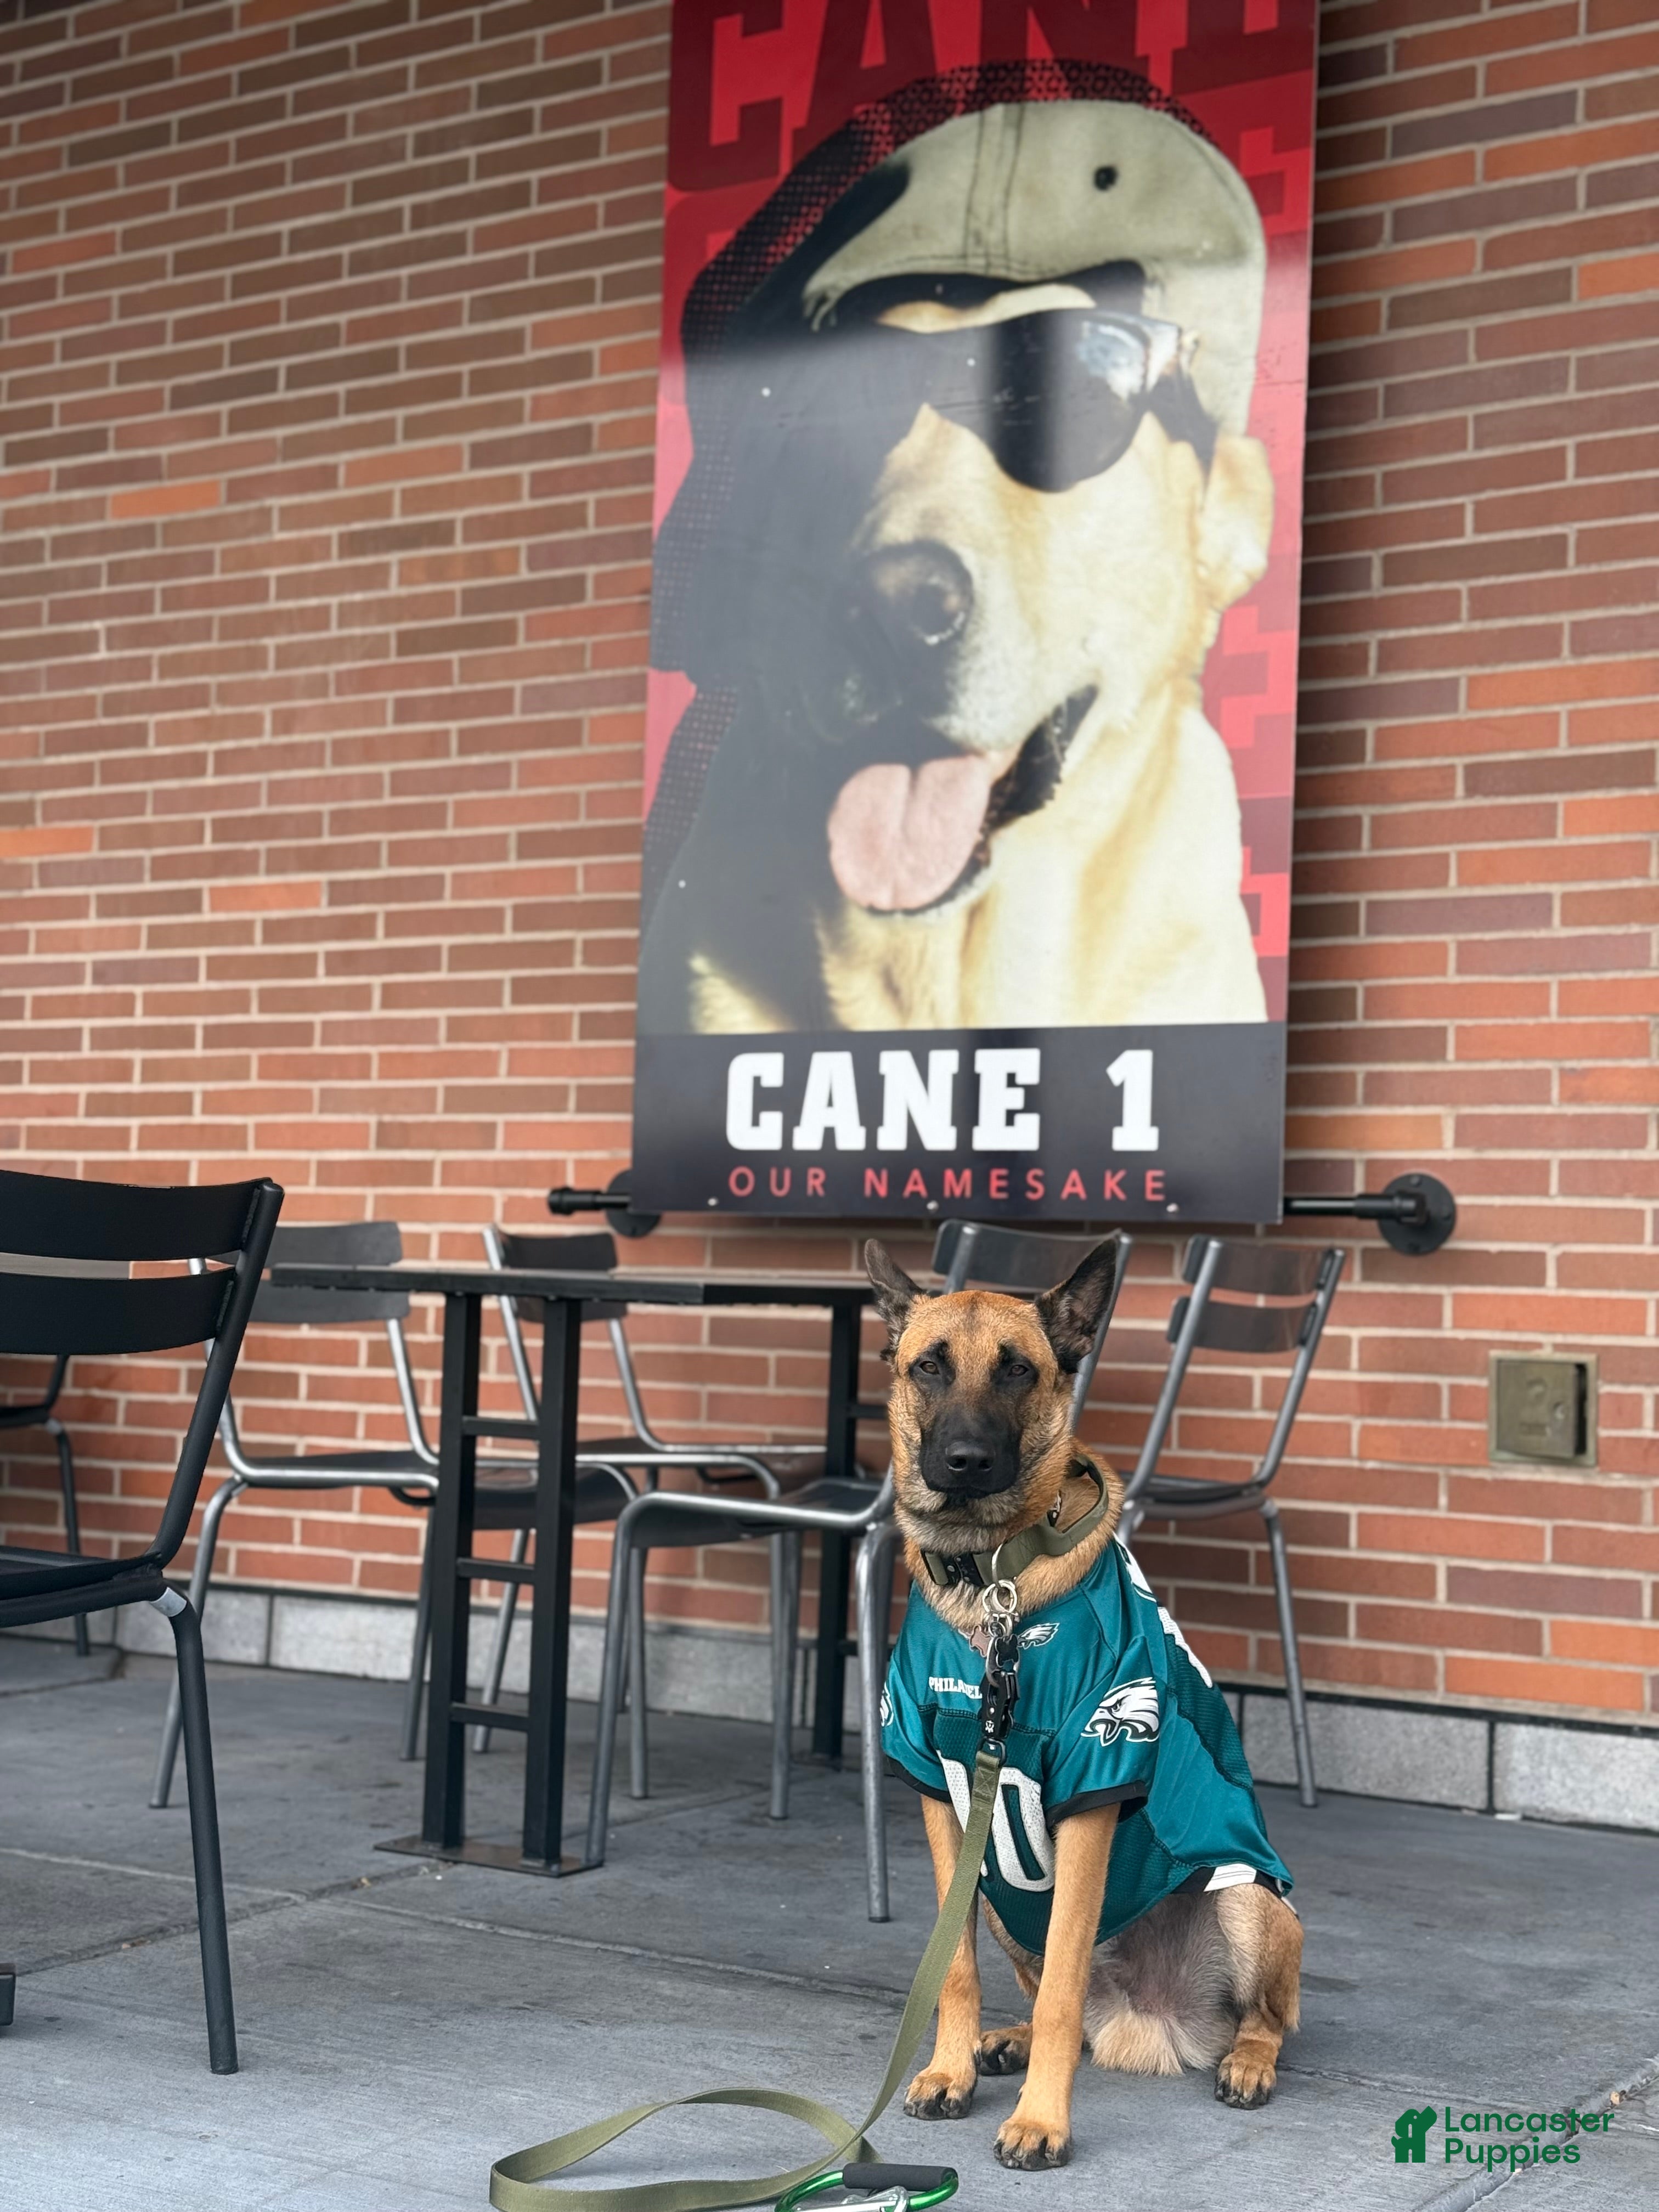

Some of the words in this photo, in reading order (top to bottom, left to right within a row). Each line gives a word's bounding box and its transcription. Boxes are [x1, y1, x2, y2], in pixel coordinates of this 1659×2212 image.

[726, 1048, 1041, 1150] CANE
[1106, 1049, 1159, 1151] 1
[728, 1166, 826, 1197] OUR
[863, 1169, 1165, 1201] NAMESAKE
